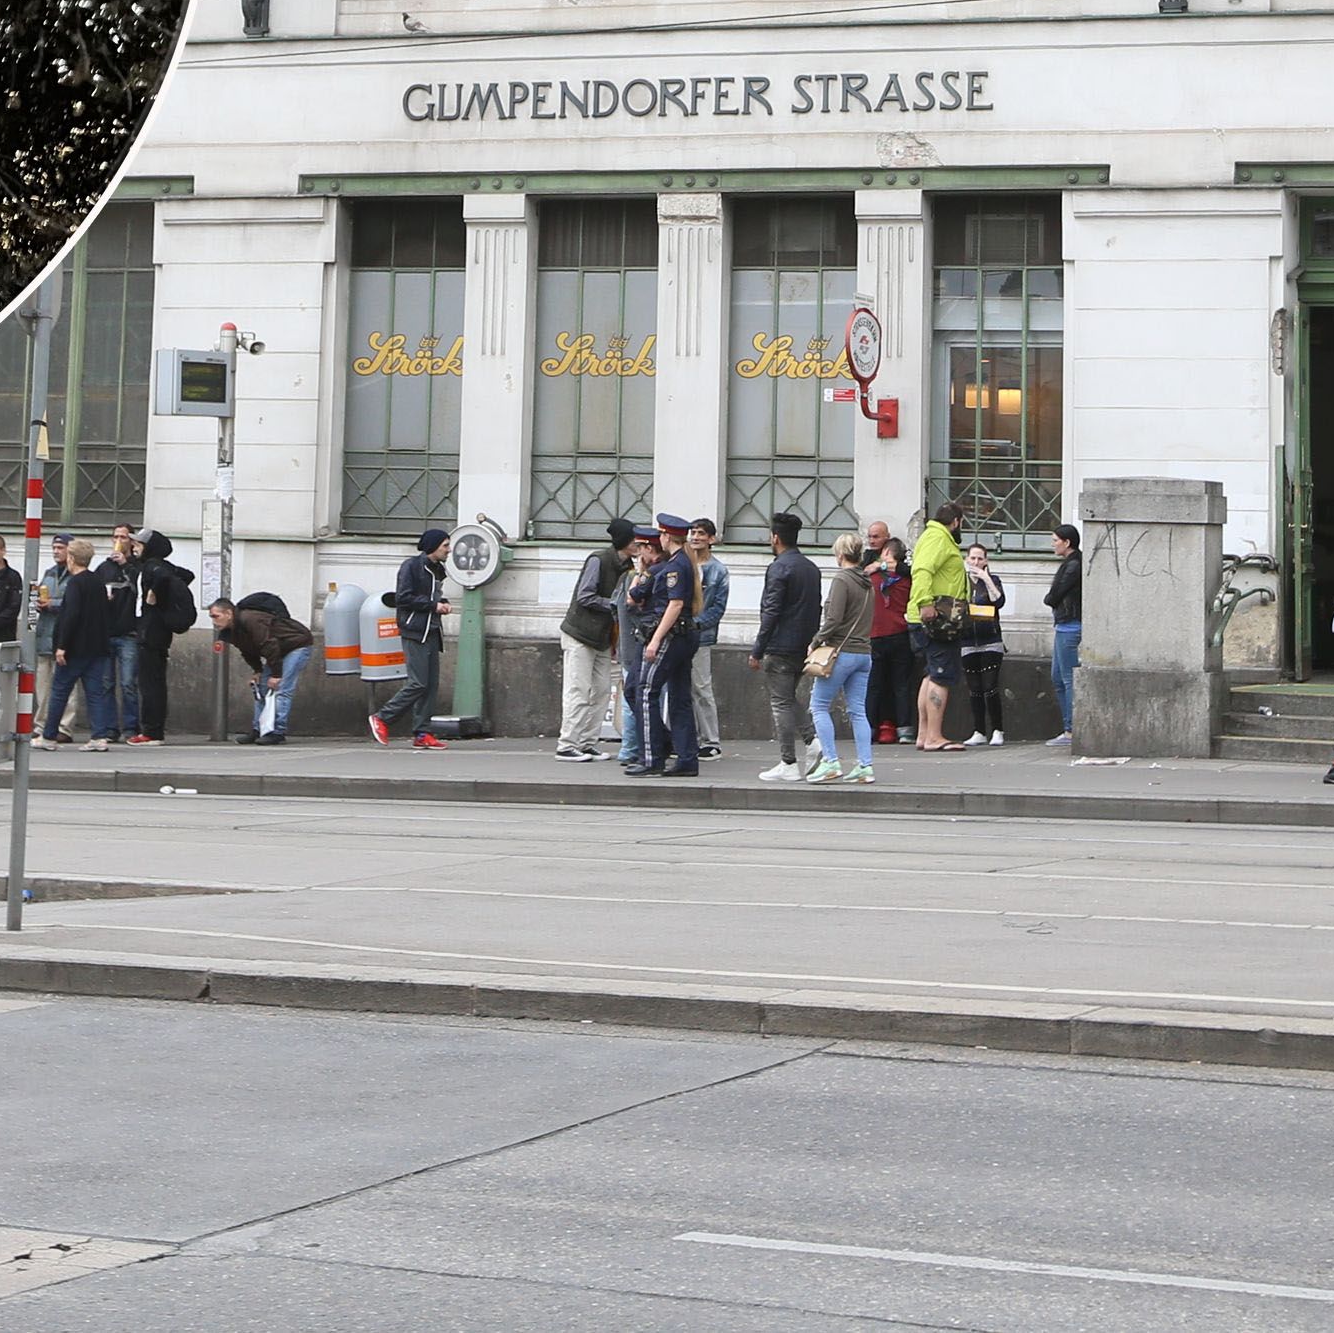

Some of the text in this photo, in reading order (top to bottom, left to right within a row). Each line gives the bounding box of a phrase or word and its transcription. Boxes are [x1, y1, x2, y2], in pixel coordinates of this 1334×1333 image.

[402, 69, 995, 122] GUMPENDORFER STRASSE
[353, 331, 464, 376] Ströck
[540, 331, 658, 377] Ströck
[736, 332, 854, 380] Ströck
